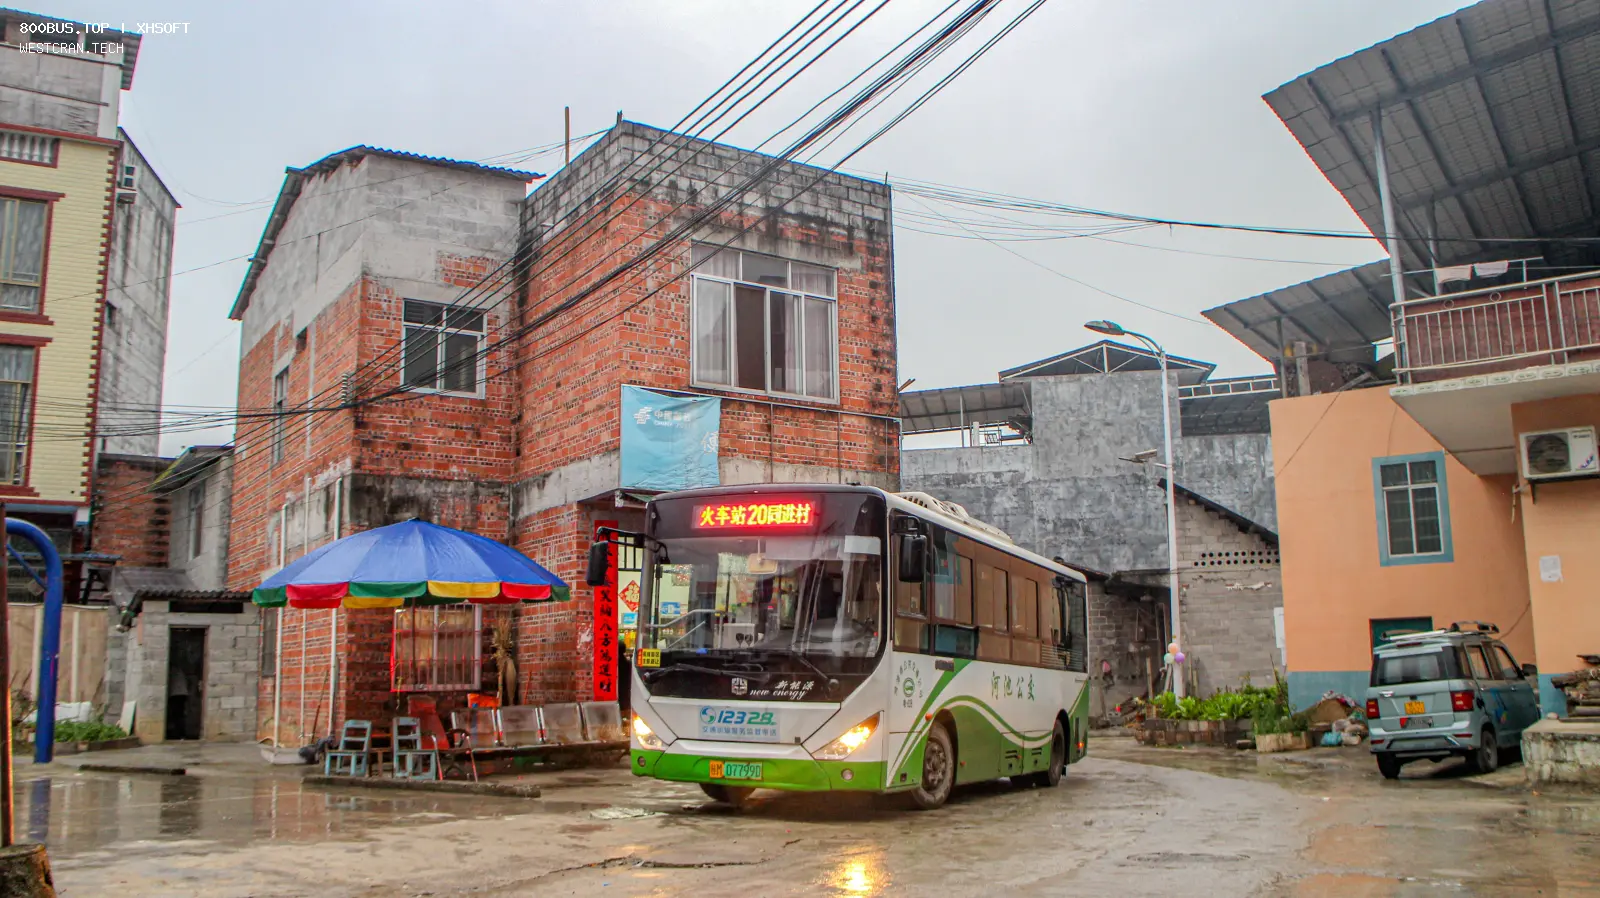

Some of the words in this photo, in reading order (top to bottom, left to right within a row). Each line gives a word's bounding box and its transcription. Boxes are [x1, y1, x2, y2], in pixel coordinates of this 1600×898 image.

[774, 680, 815, 691] 新能源
[991, 670, 1035, 702] 河池公交
[772, 688, 807, 700] energy
[717, 710, 775, 725] 12328
